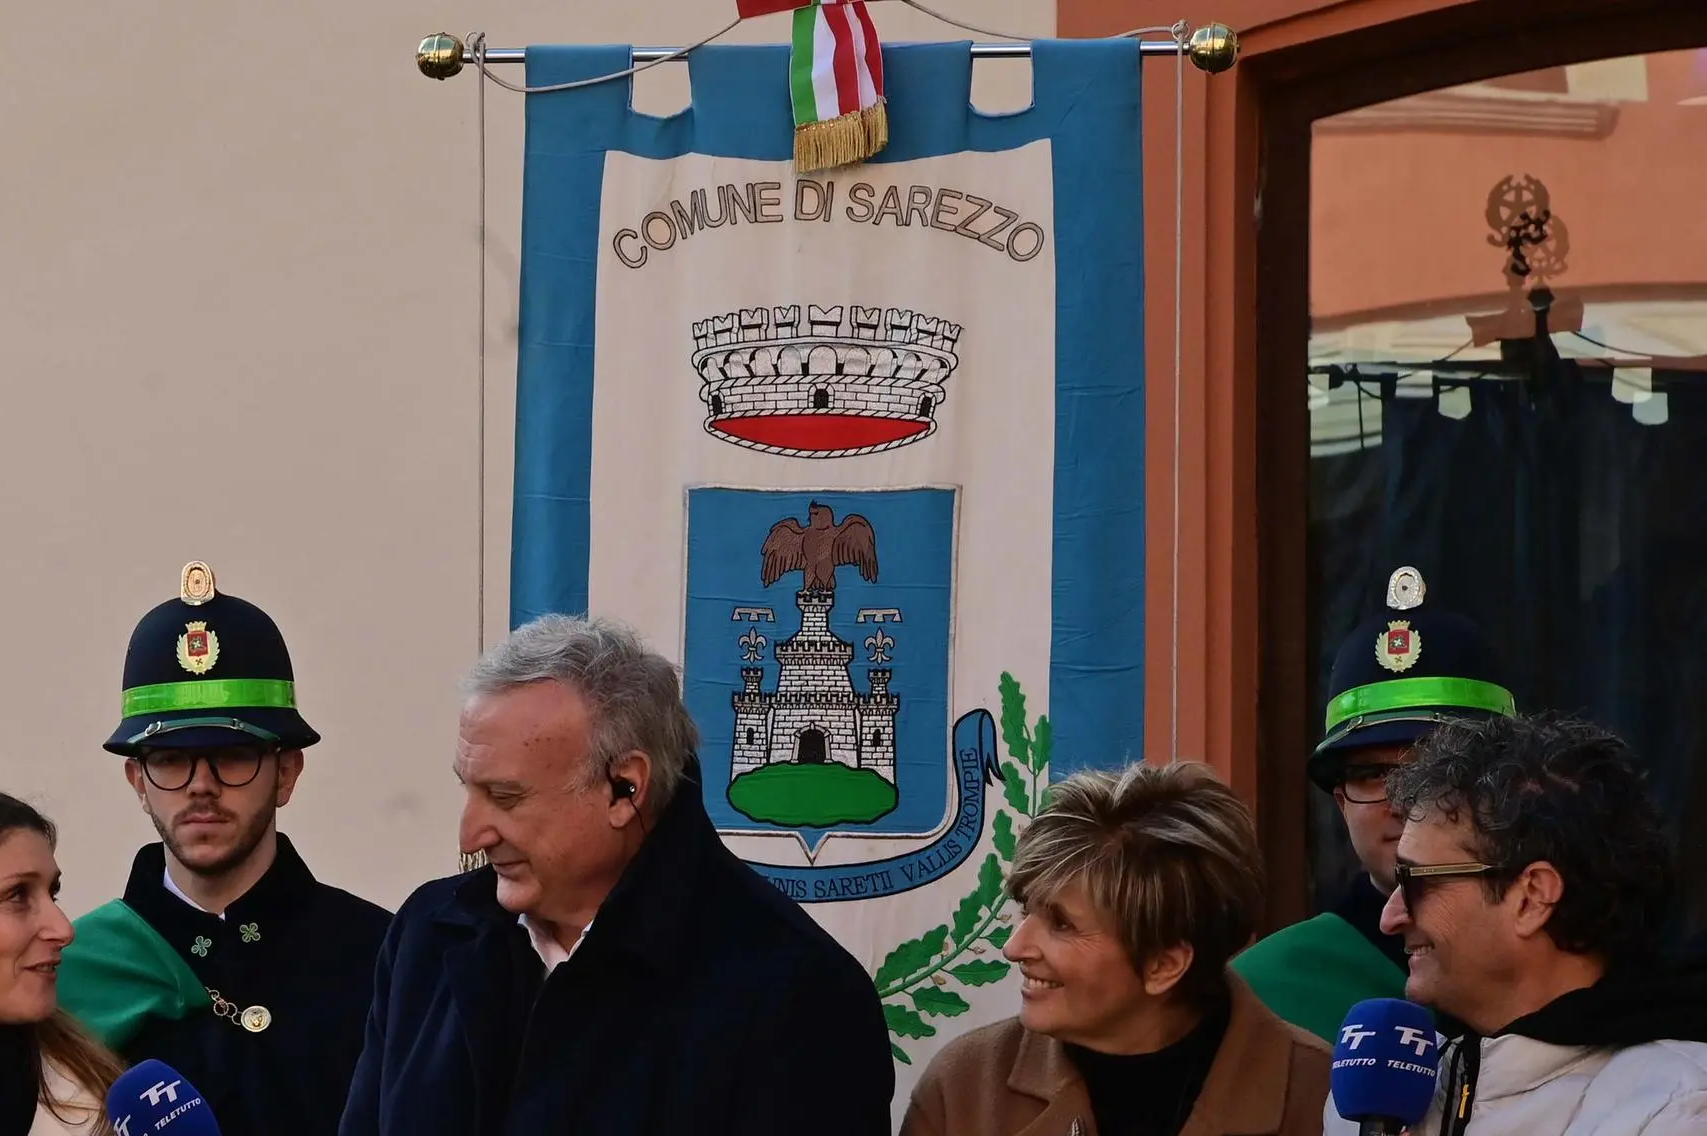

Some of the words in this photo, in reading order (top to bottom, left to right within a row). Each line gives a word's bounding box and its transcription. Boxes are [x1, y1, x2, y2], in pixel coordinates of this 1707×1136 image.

[612, 181, 783, 269] COMUNE
[794, 179, 834, 222] DI
[844, 182, 1045, 262] SAREZZO
[899, 839, 963, 882] VALLIS
[1387, 1059, 1436, 1077] TELETUTTO
[154, 1097, 201, 1131] TELETUTTO
